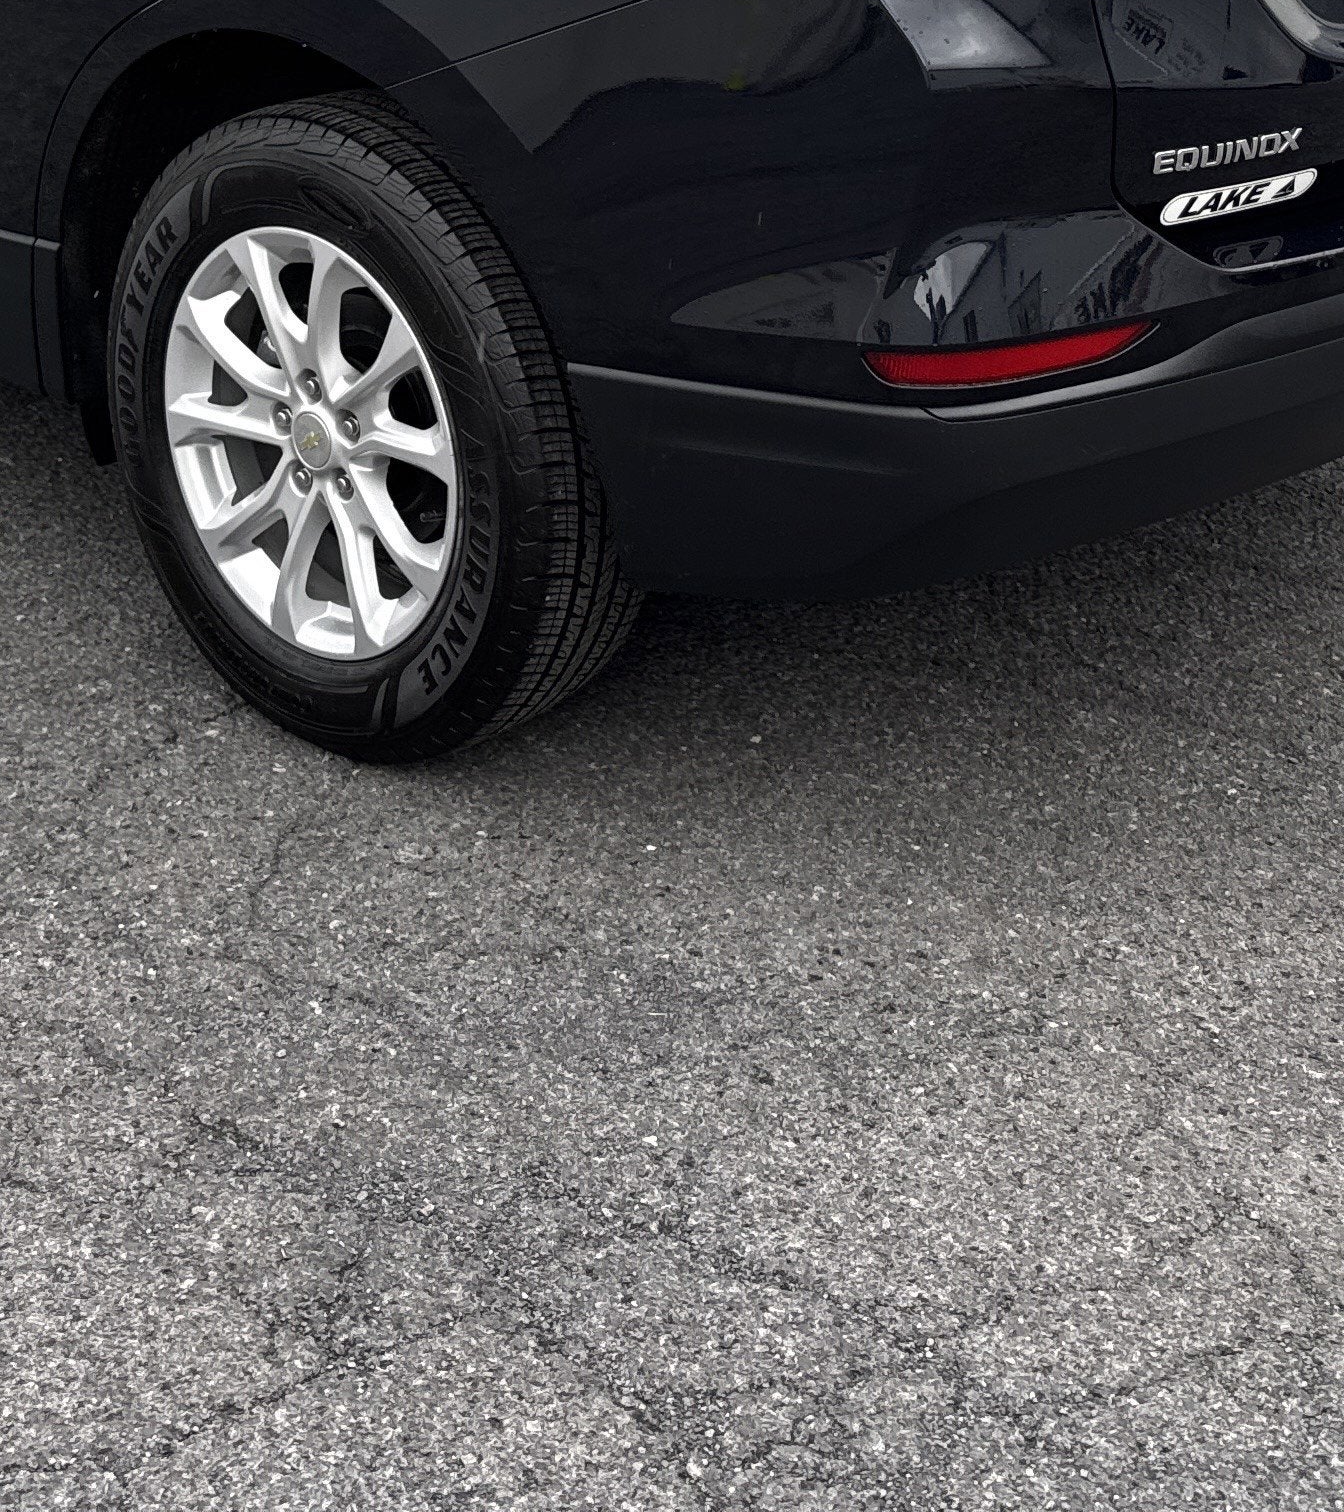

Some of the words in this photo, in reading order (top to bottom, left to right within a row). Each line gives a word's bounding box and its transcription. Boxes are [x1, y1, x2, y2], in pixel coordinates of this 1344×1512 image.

[1152, 127, 1304, 175] EQUINOX
[1176, 181, 1272, 219] LAKE
[416, 428, 492, 696] ASSURANCE
